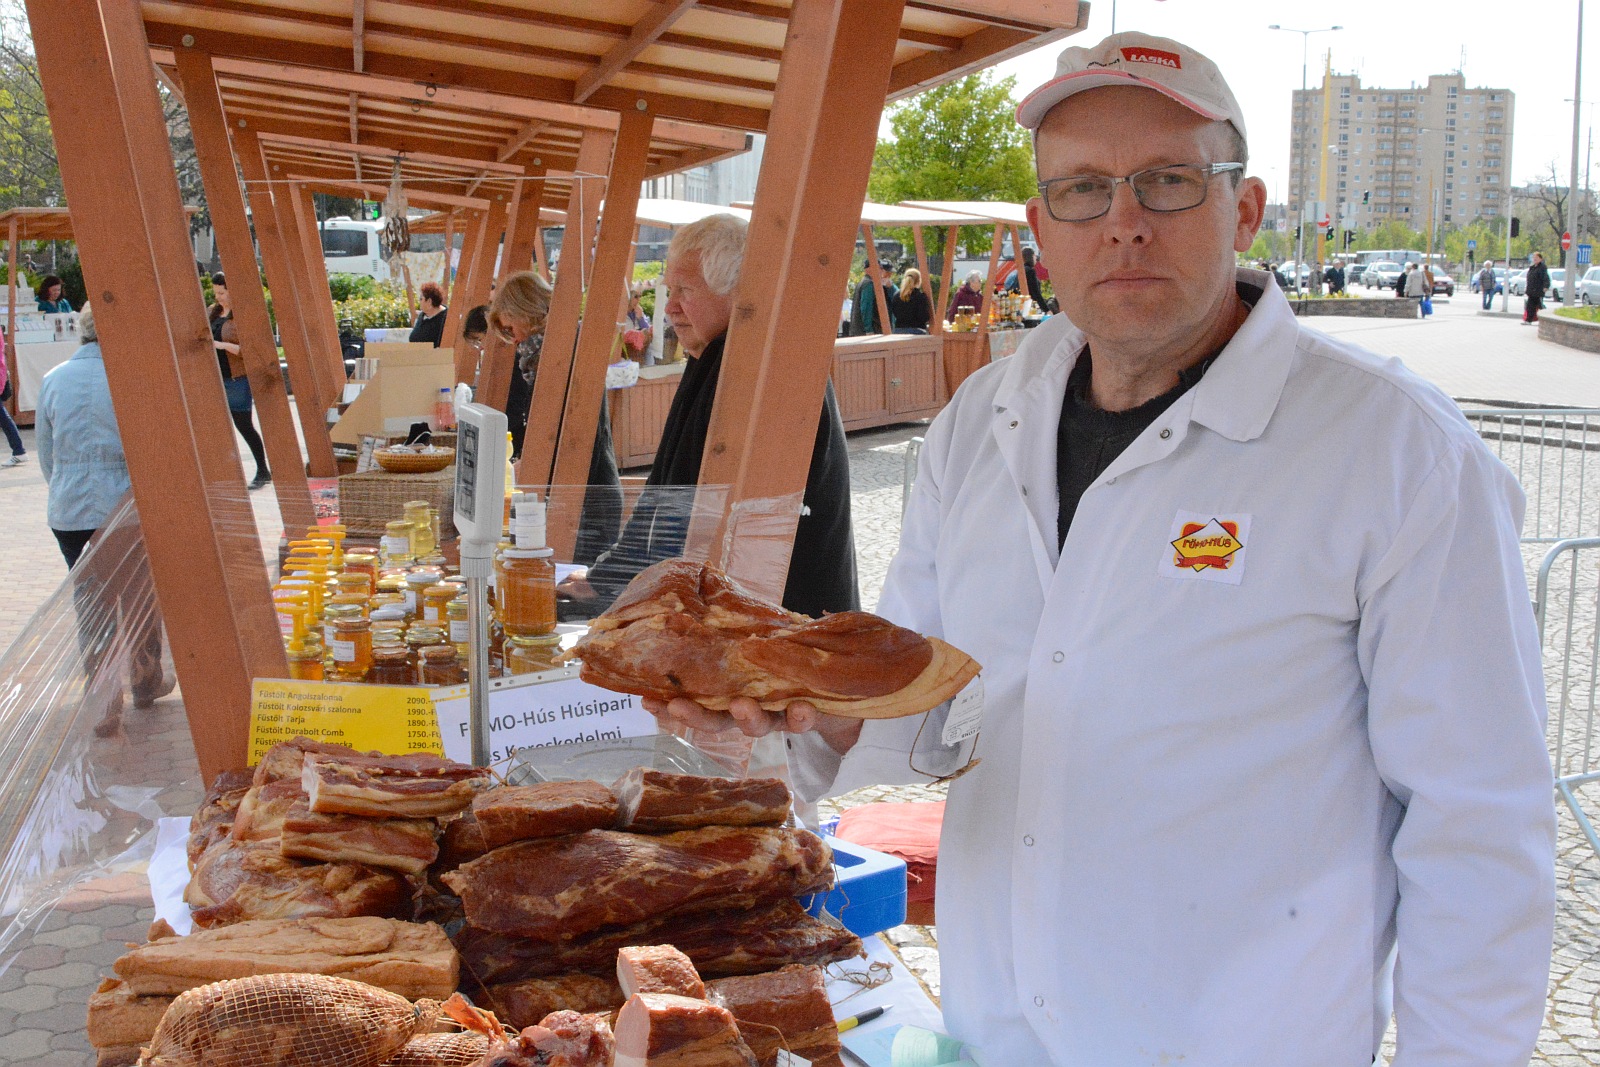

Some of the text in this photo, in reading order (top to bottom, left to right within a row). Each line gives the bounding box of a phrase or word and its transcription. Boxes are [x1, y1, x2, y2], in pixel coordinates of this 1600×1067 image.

[1131, 54, 1177, 67] LASKA
[259, 690, 286, 699] Füstölt
[287, 692, 343, 702] Angolszalonna
[258, 702, 284, 711] Füstölt
[286, 703, 326, 713] Kolozsvári
[327, 705, 362, 714] szalonna
[257, 713, 283, 722] Füstölt
[286, 715, 305, 725] Tarja
[459, 694, 632, 737] FMO-Hús Húsipari
[256, 725, 283, 735] Füstölt
[285, 727, 319, 736] Darabolt
[321, 728, 344, 737] Comb
[255, 737, 282, 747] Füstö
[488, 750, 501, 762] s
